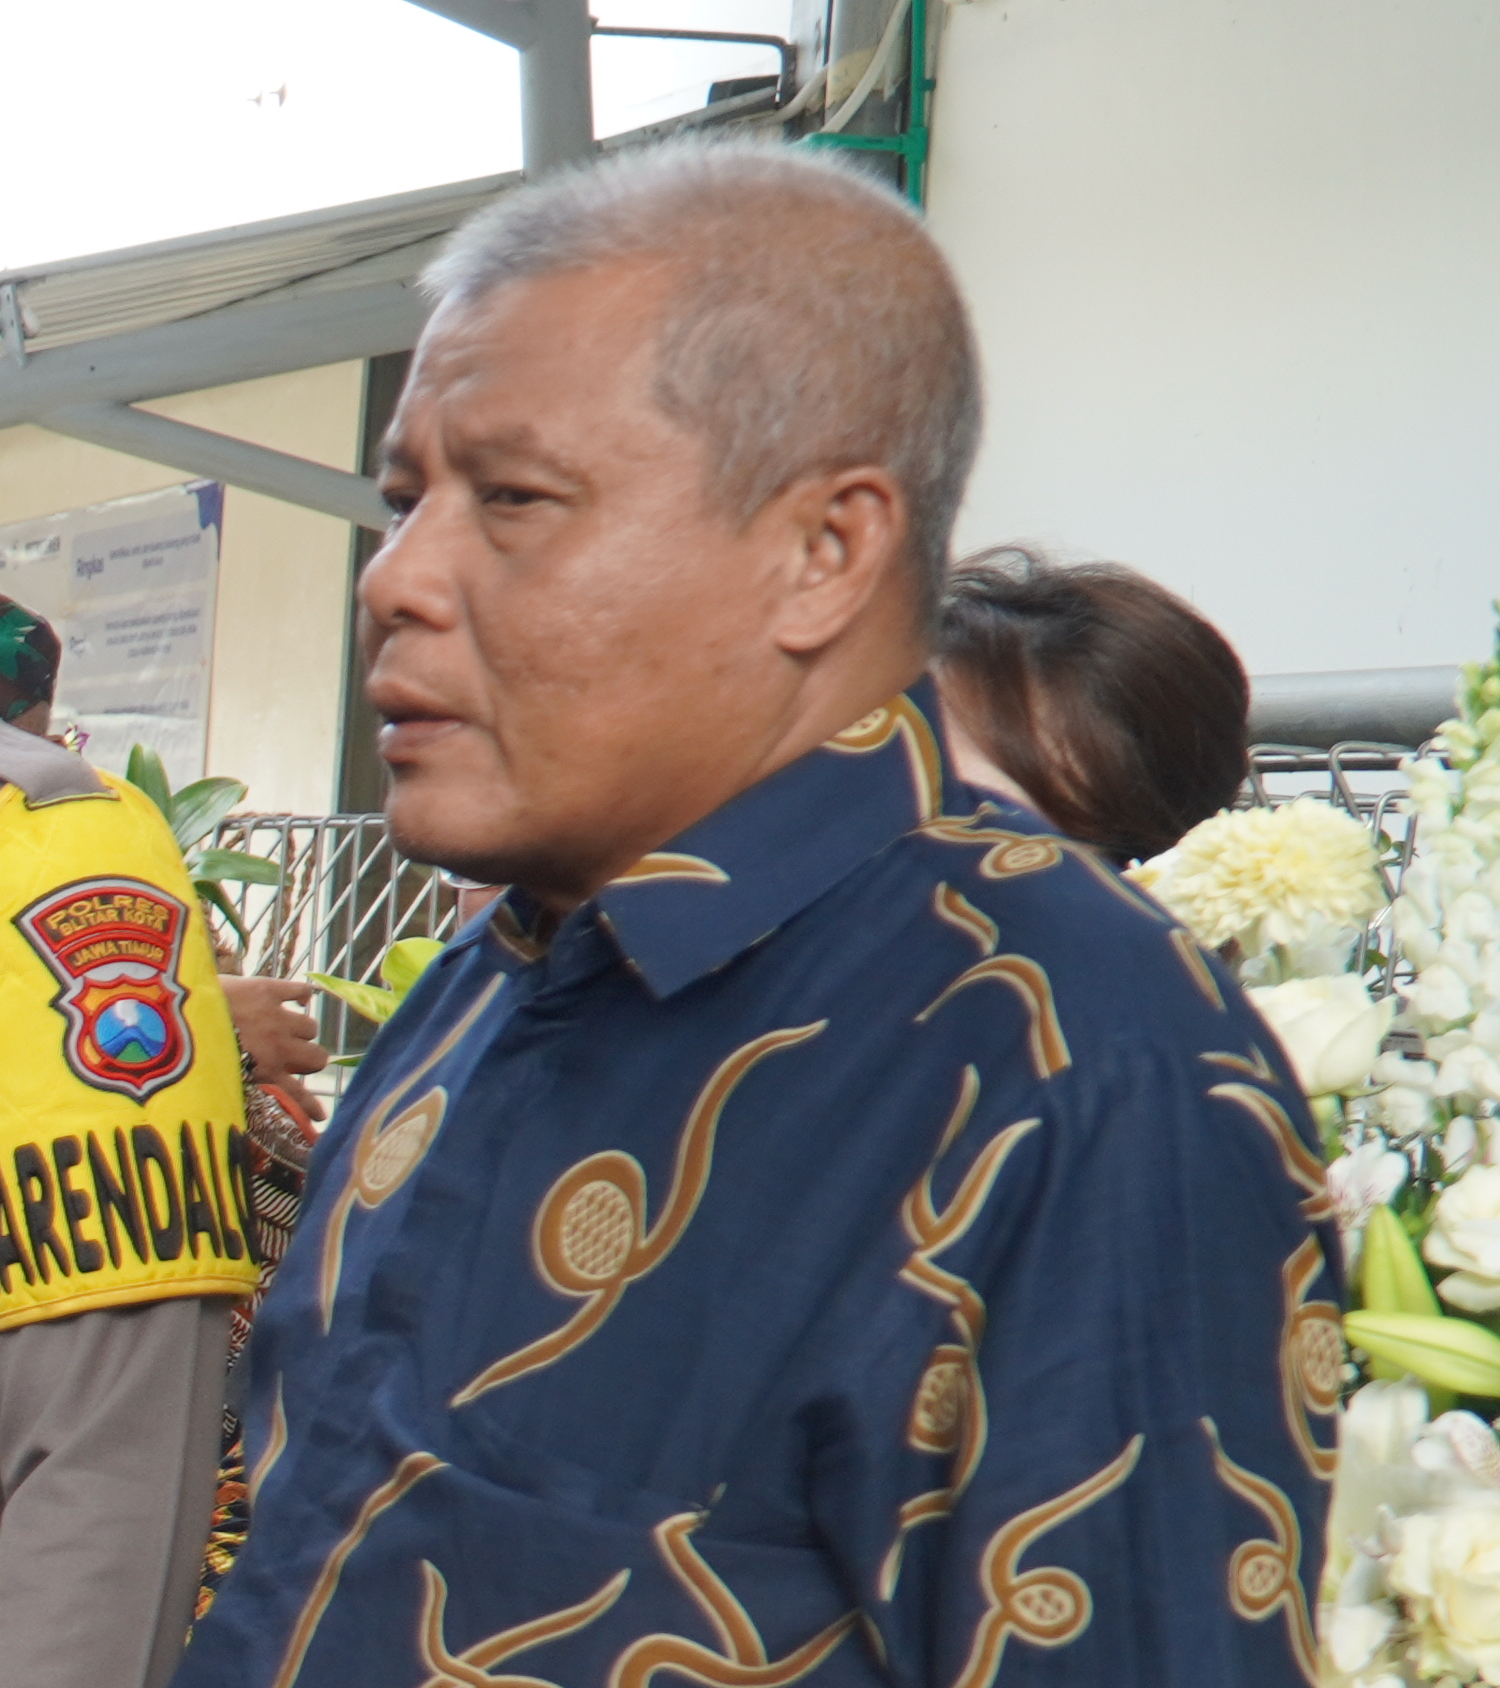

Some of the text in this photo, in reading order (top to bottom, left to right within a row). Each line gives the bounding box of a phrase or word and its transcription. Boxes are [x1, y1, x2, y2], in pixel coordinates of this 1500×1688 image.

[47, 895, 169, 931] POLRES
[59, 907, 165, 936] BLITAR KOTA
[73, 940, 165, 967] JAWA TIMUR
